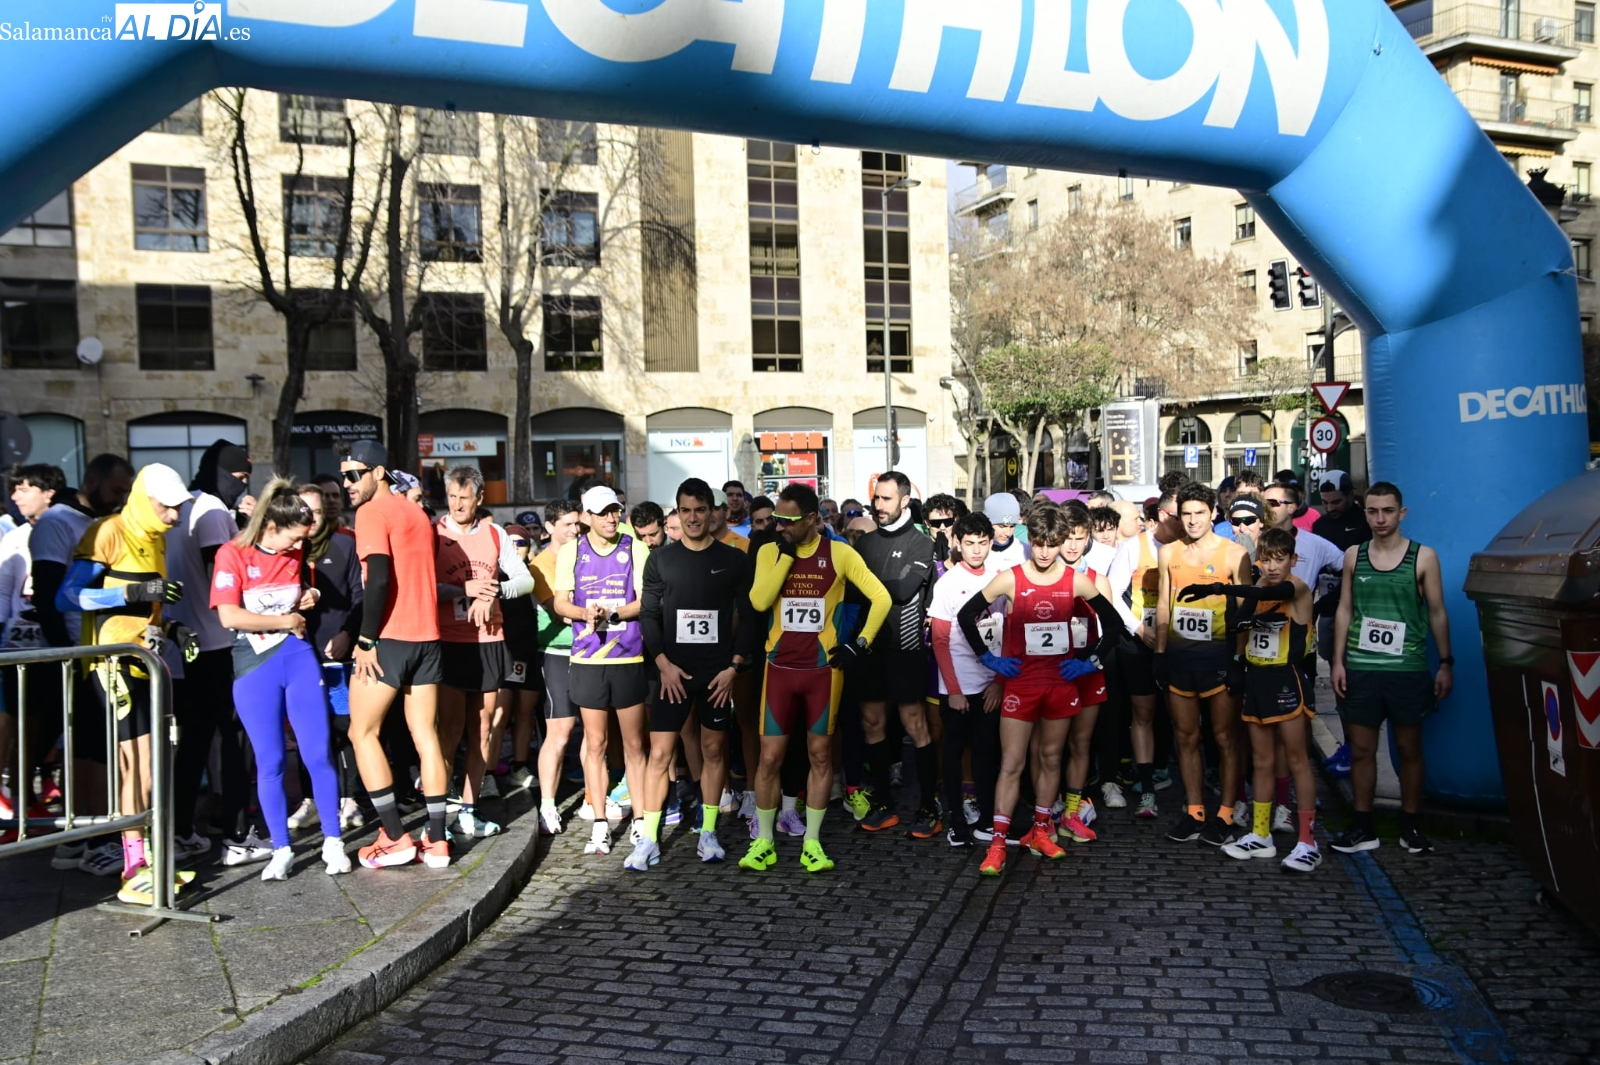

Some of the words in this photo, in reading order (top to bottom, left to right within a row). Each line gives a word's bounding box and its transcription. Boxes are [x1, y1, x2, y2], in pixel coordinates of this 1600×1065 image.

[670, 438, 691, 447] ING
[1316, 429, 1333, 441] 30
[436, 442, 461, 452] ING
[784, 608, 821, 624] 179
[686, 620, 710, 636] 13
[1177, 616, 1208, 633] 105
[984, 628, 994, 642] 4
[1041, 632, 1054, 648] 2
[1253, 633, 1270, 650] 15
[1368, 629, 1394, 646] 60
